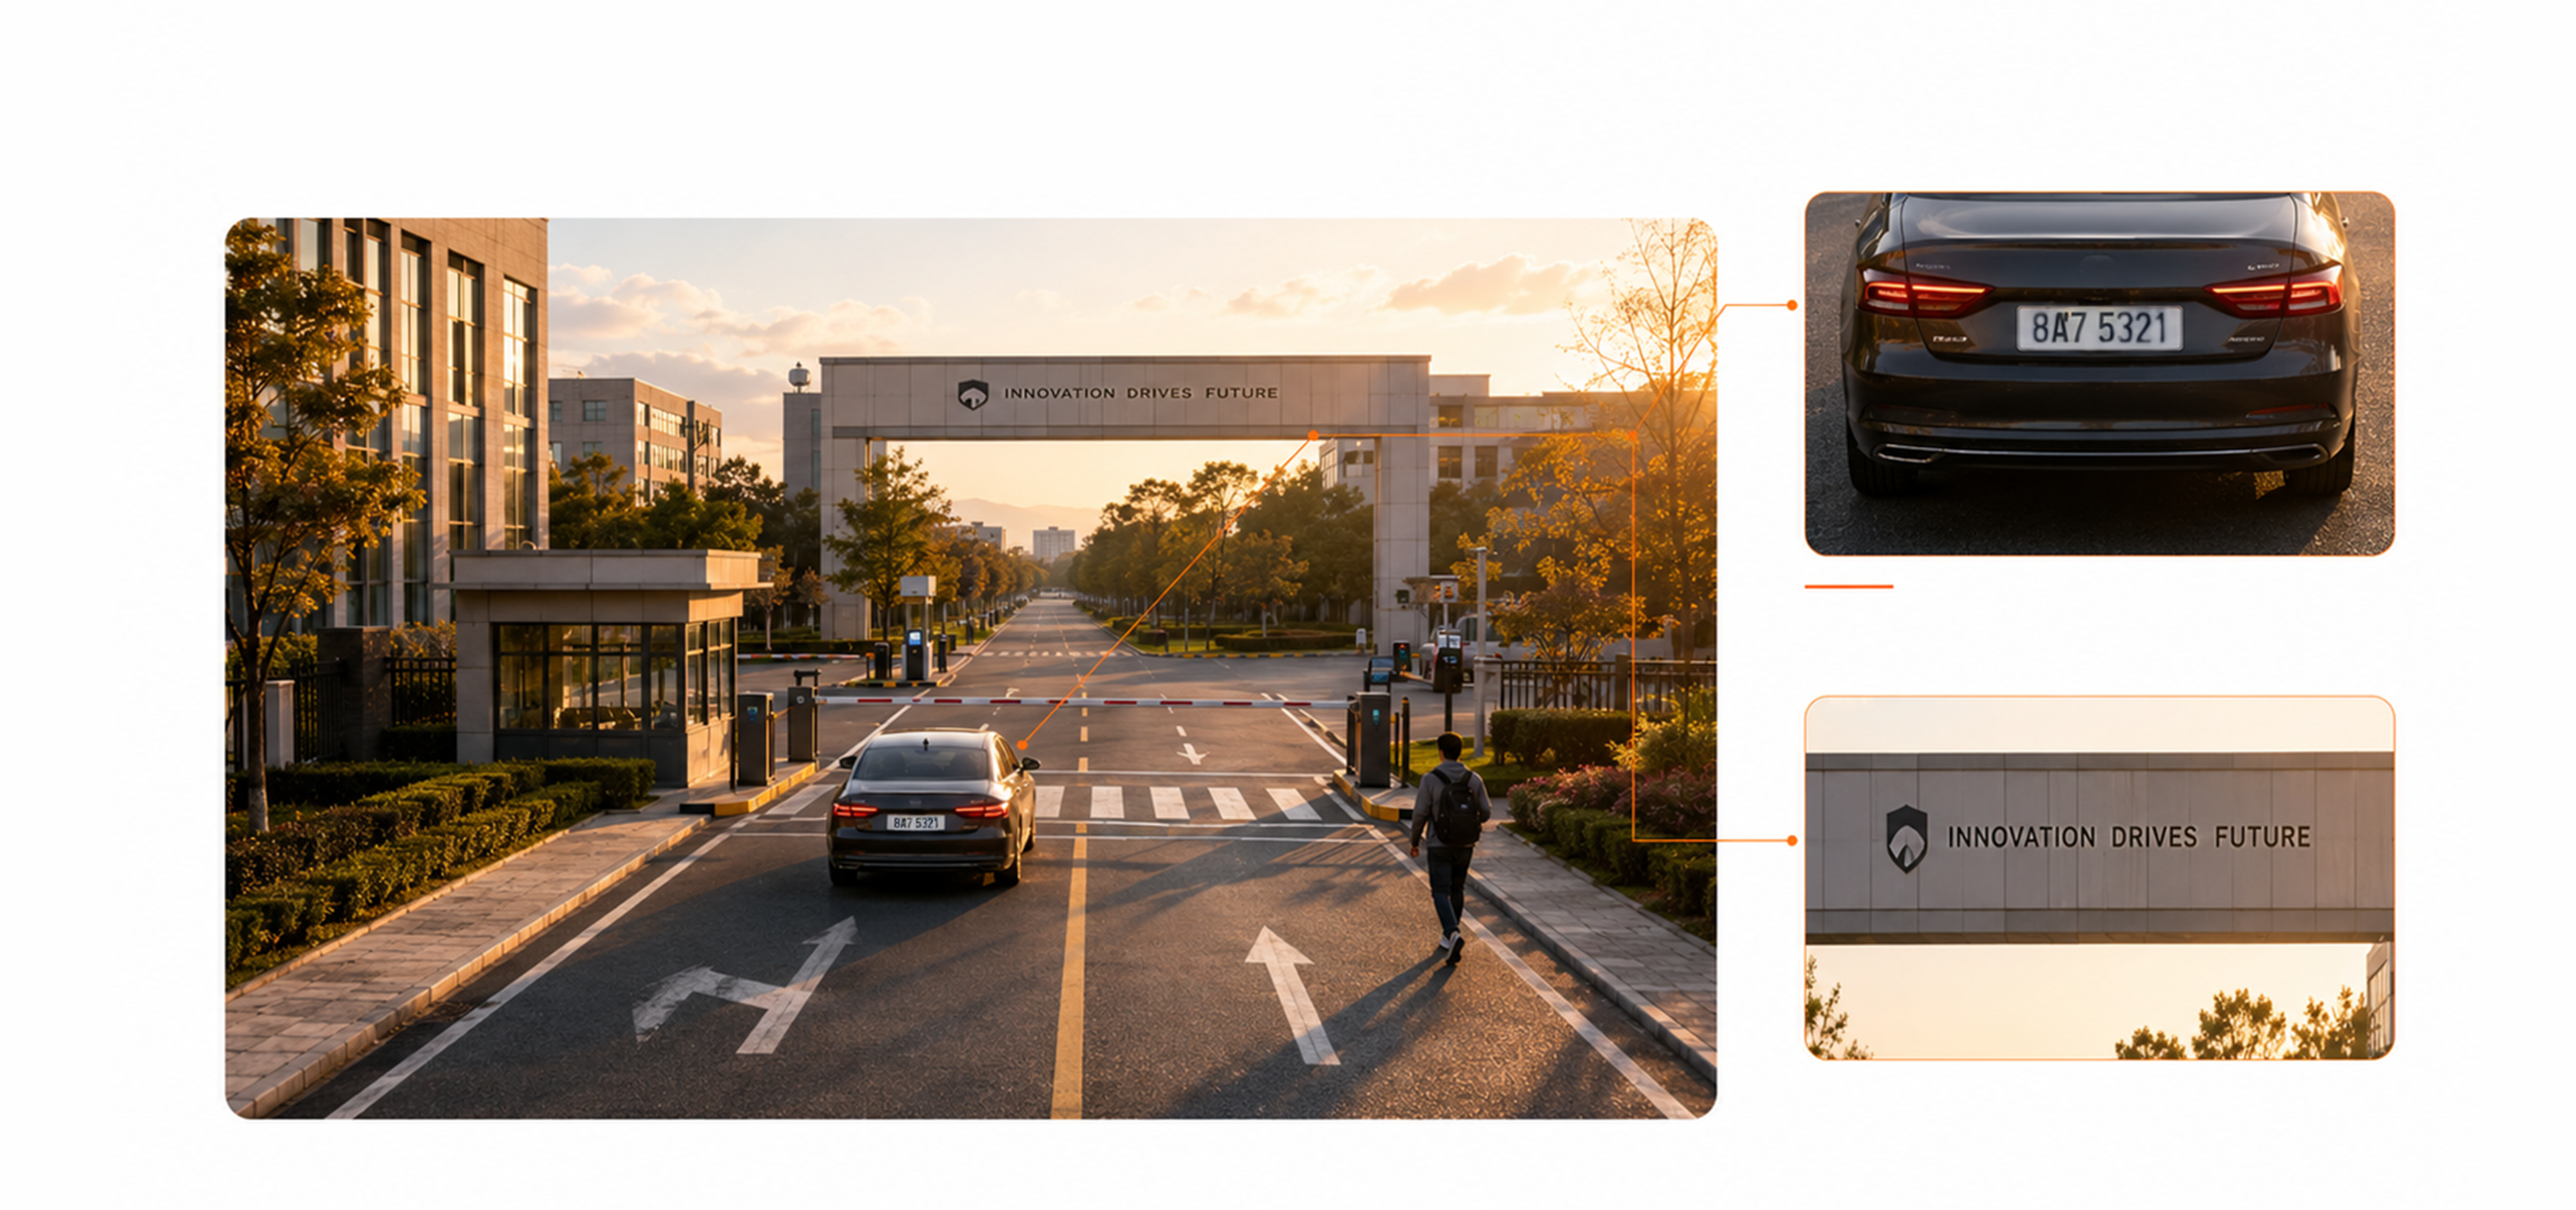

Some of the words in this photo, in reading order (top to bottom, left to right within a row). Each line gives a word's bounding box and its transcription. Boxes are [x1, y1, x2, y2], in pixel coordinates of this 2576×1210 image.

[2033, 311, 2087, 343] 8A7
[2098, 311, 2165, 343] 5321
[1005, 387, 1115, 399] INNOVATION
[1127, 387, 1192, 399] DRIVES
[1206, 387, 1278, 399] FUTURE
[915, 817, 938, 829] 5321
[1948, 825, 2096, 848] INNOVATION
[2112, 825, 2198, 848] DRIVES
[2215, 825, 2311, 848] FUTURE
